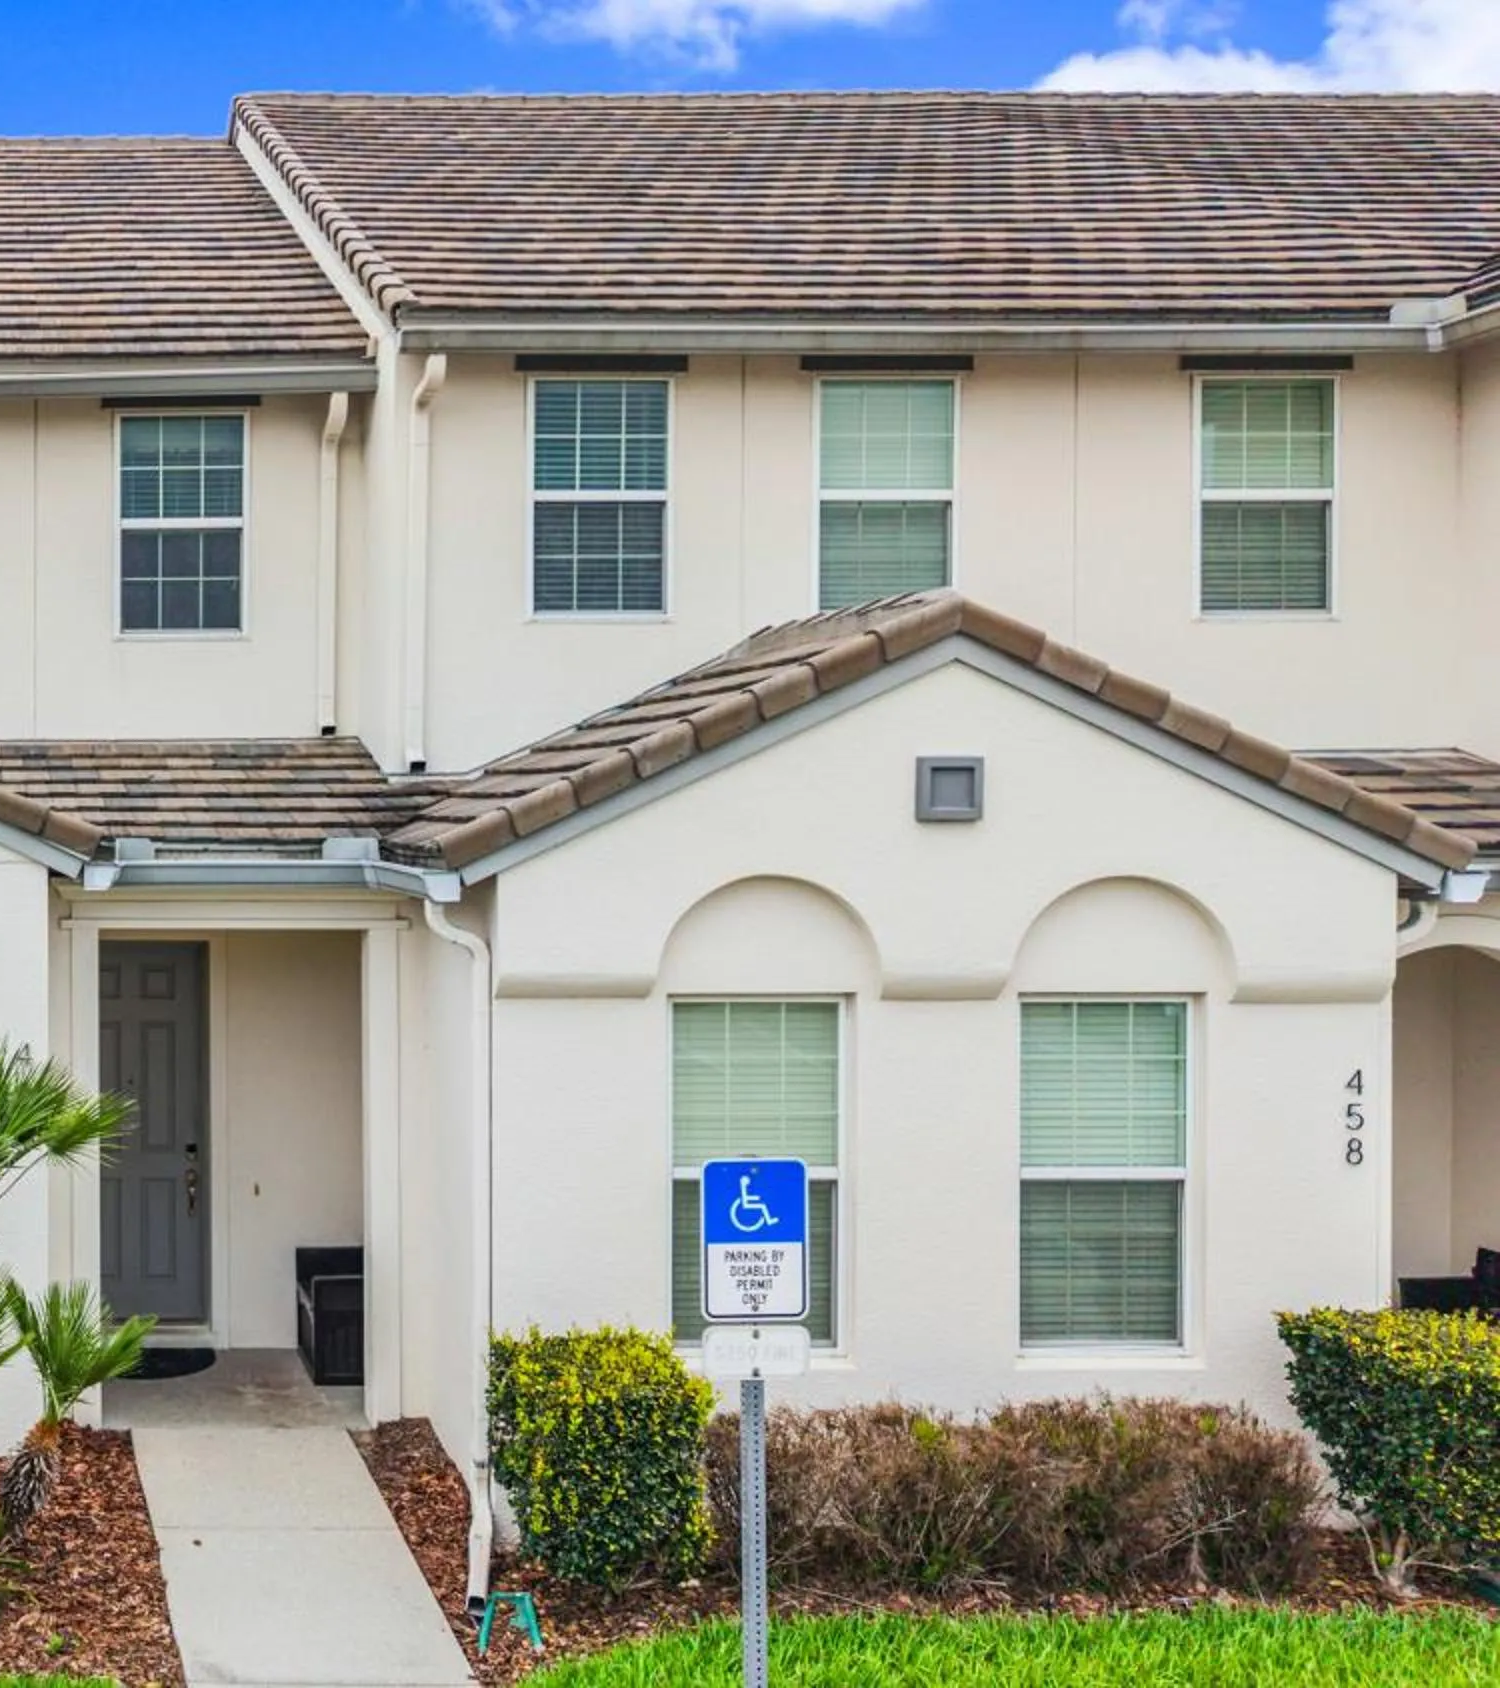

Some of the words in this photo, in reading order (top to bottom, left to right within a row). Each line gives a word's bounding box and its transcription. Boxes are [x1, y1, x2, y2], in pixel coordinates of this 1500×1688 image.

[1345, 1068, 1365, 1166] 458
[724, 1250, 767, 1262] PARKING
[771, 1249, 785, 1262] BY
[729, 1265, 780, 1277] DISABLED
[736, 1279, 773, 1291] PERMIT
[742, 1294, 768, 1305] ONLY
